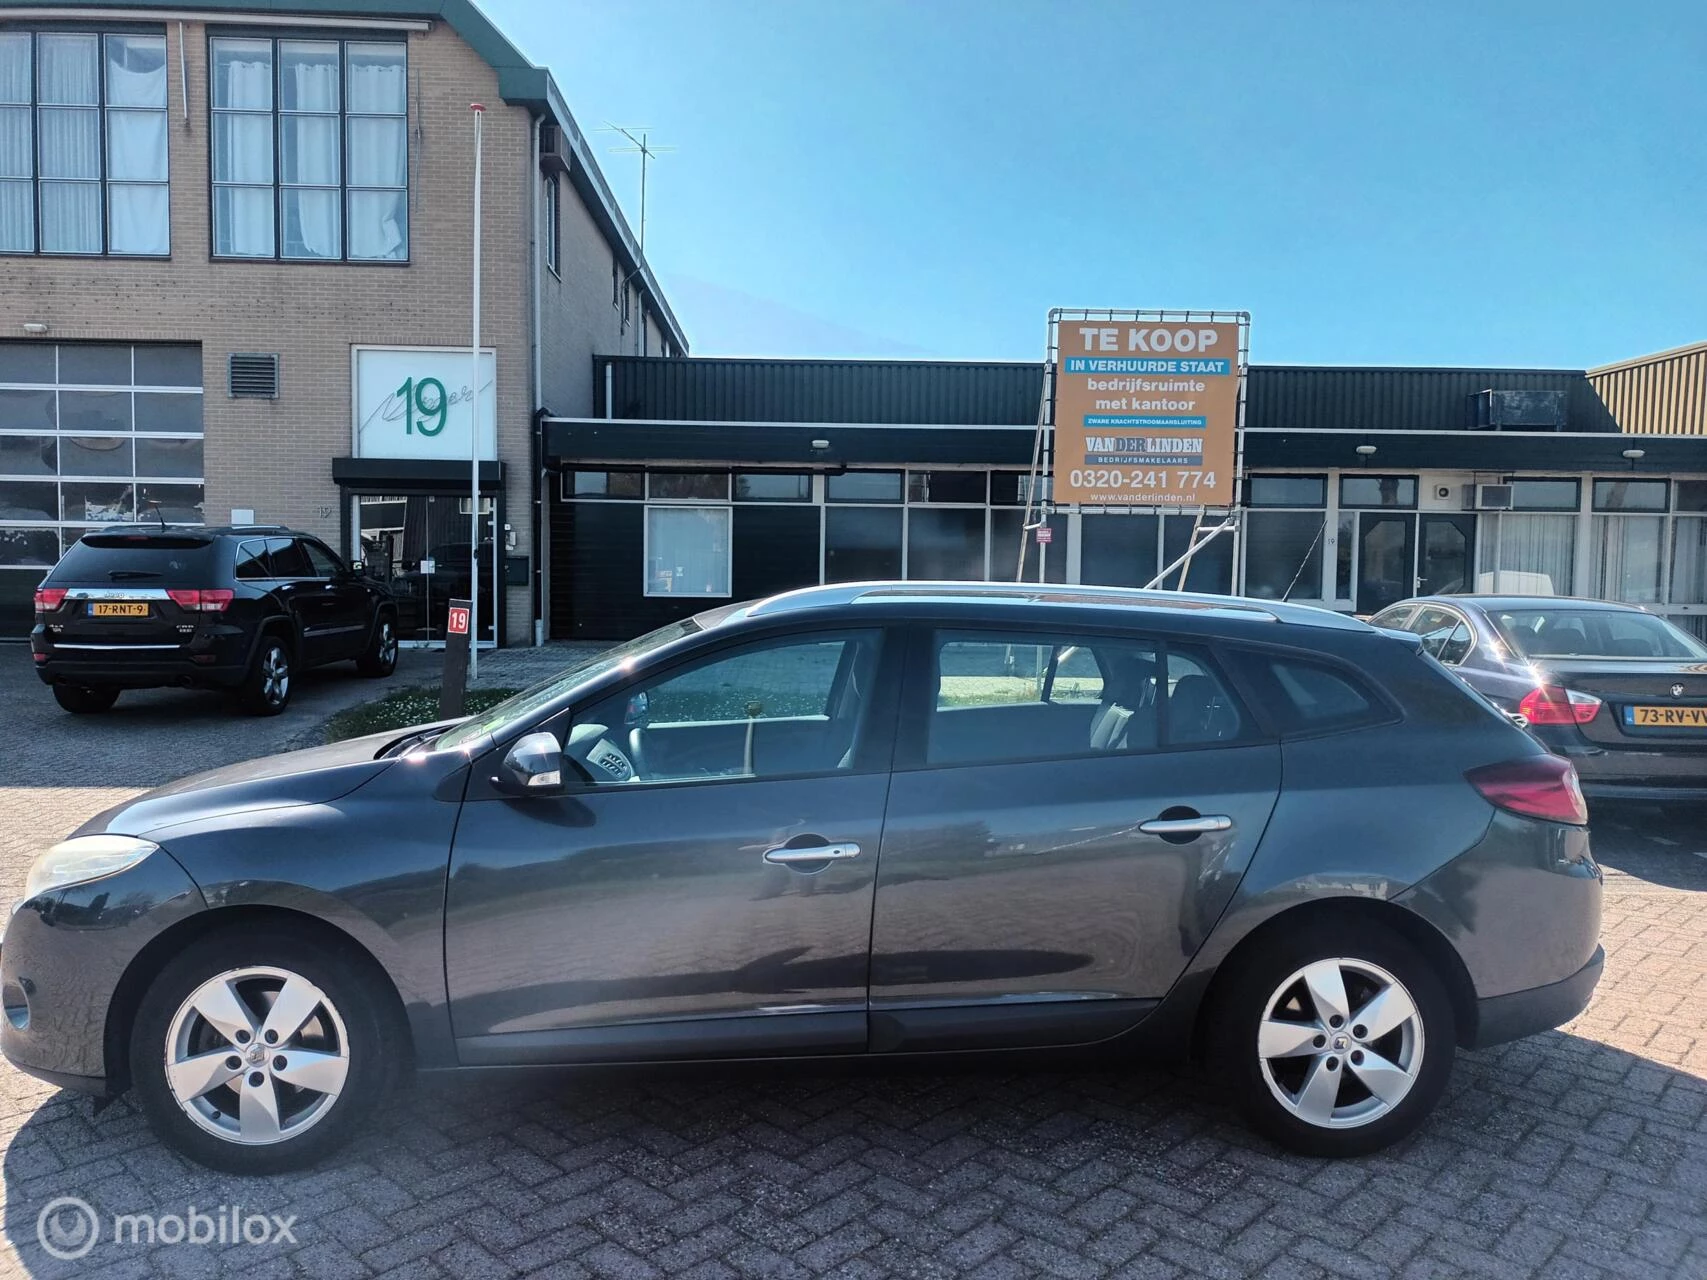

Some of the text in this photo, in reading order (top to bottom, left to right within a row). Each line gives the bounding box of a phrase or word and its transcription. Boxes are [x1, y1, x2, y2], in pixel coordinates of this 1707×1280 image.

[1079, 327, 1219, 352] TE KOOP
[1070, 359, 1225, 373] IN VERHUURDE STAAT
[1087, 378, 1206, 393] bedrijfsruimte
[396, 376, 448, 437] 19
[1095, 398, 1196, 411] met kantoor
[1097, 456, 1189, 464] BEDRIJFSMAKELAARS
[1070, 469, 1217, 489] 0320-241 774
[1090, 492, 1196, 502] www.vanderlinden.nl
[98, 604, 144, 615] 17-RNT-9
[451, 612, 466, 629] 19
